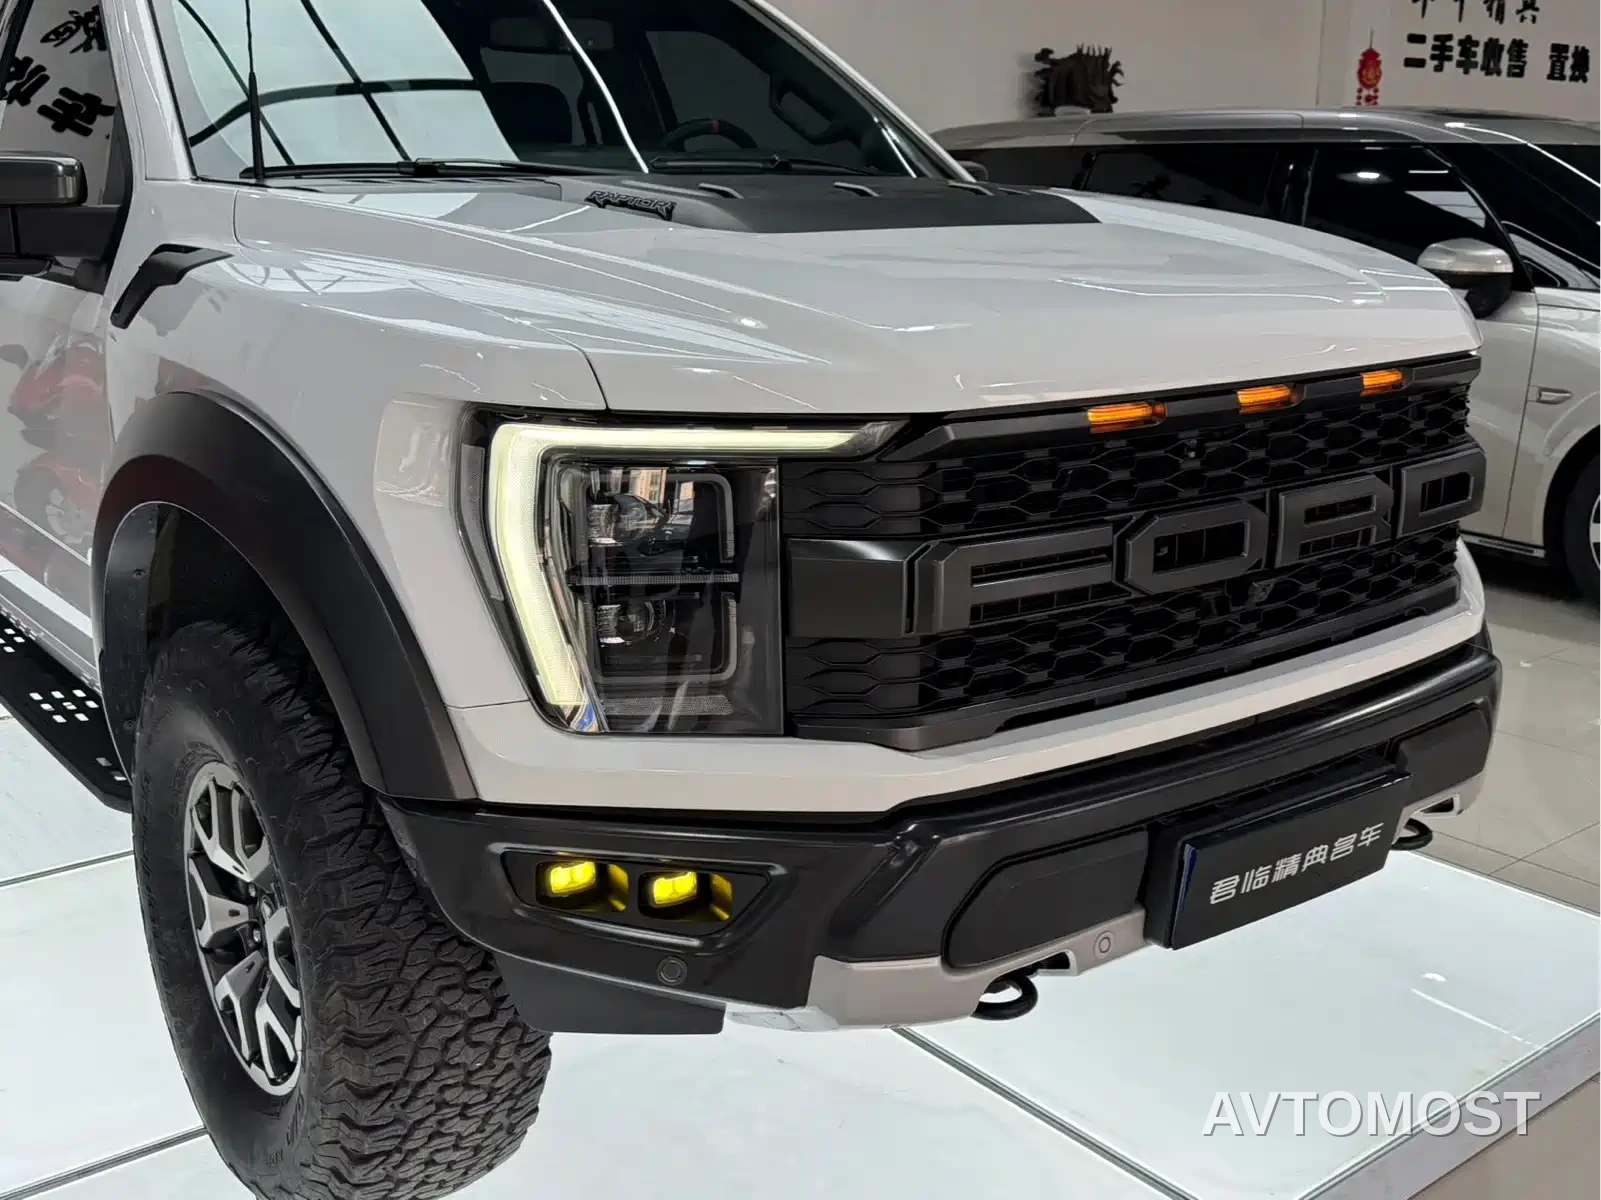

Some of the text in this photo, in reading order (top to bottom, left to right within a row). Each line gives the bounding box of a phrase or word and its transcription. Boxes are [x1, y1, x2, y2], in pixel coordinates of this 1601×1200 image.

[1404, 33, 1590, 84] 二手车收售 置换
[584, 190, 677, 221] RAPTOR
[932, 445, 1486, 634] FORD
